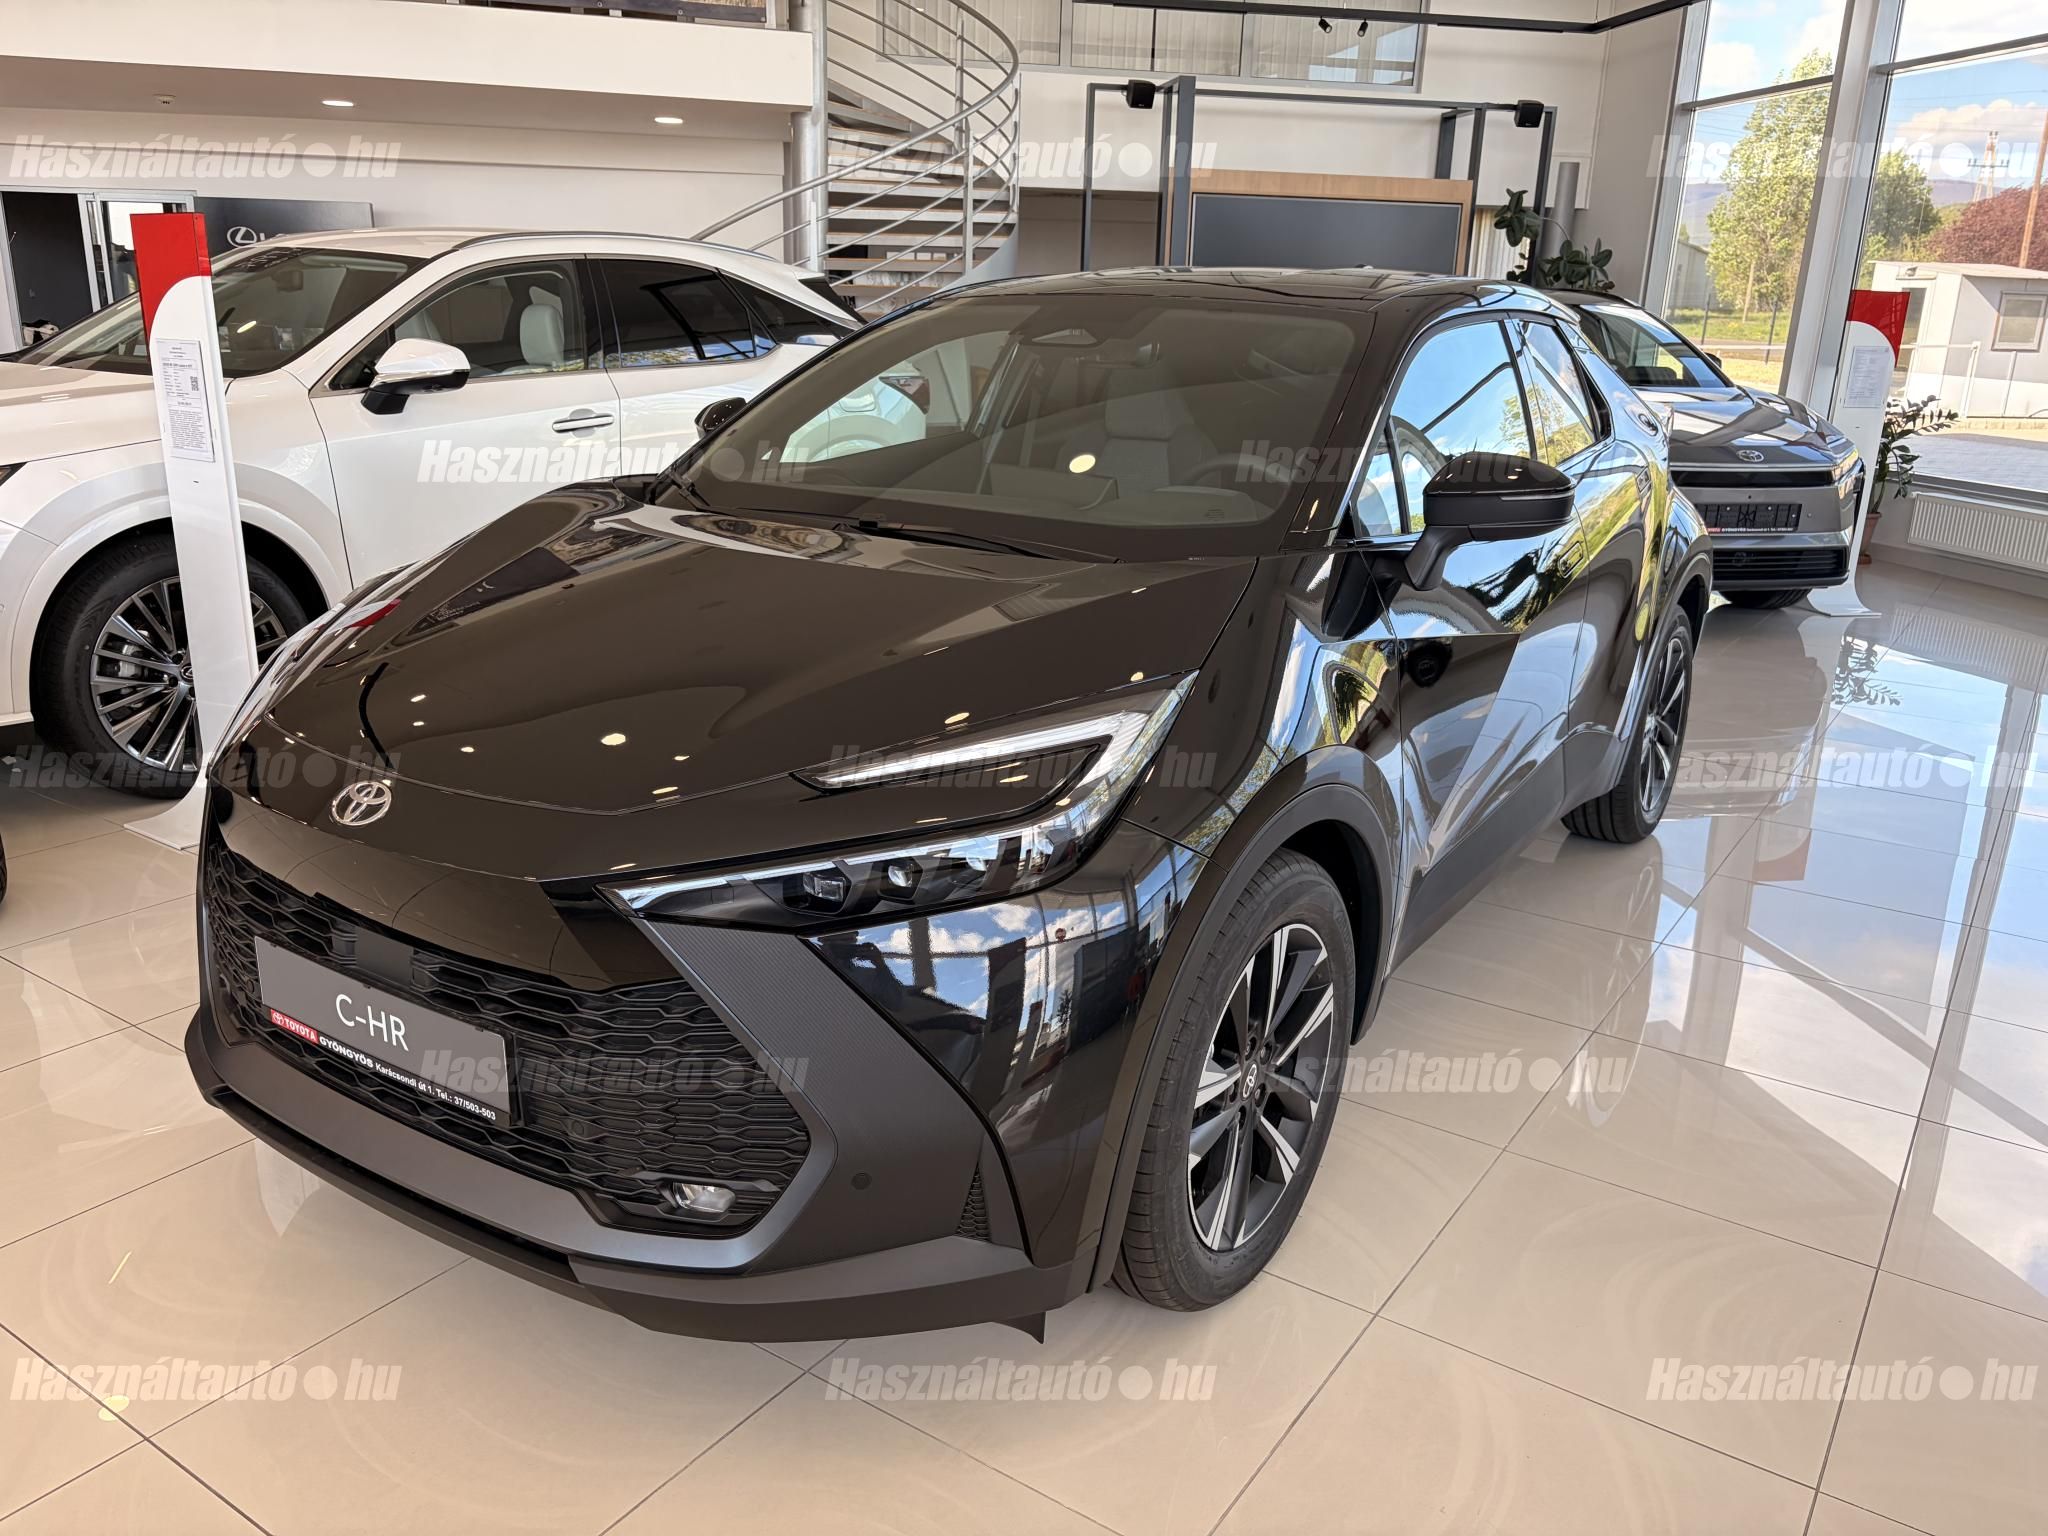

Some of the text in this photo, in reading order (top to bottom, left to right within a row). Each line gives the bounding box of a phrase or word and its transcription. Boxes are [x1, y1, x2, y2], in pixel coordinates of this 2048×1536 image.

[284, 1018, 317, 1041] TOYOTA
[319, 1036, 374, 1068] GYÖNGYÖS
[335, 993, 409, 1051] C-HR
